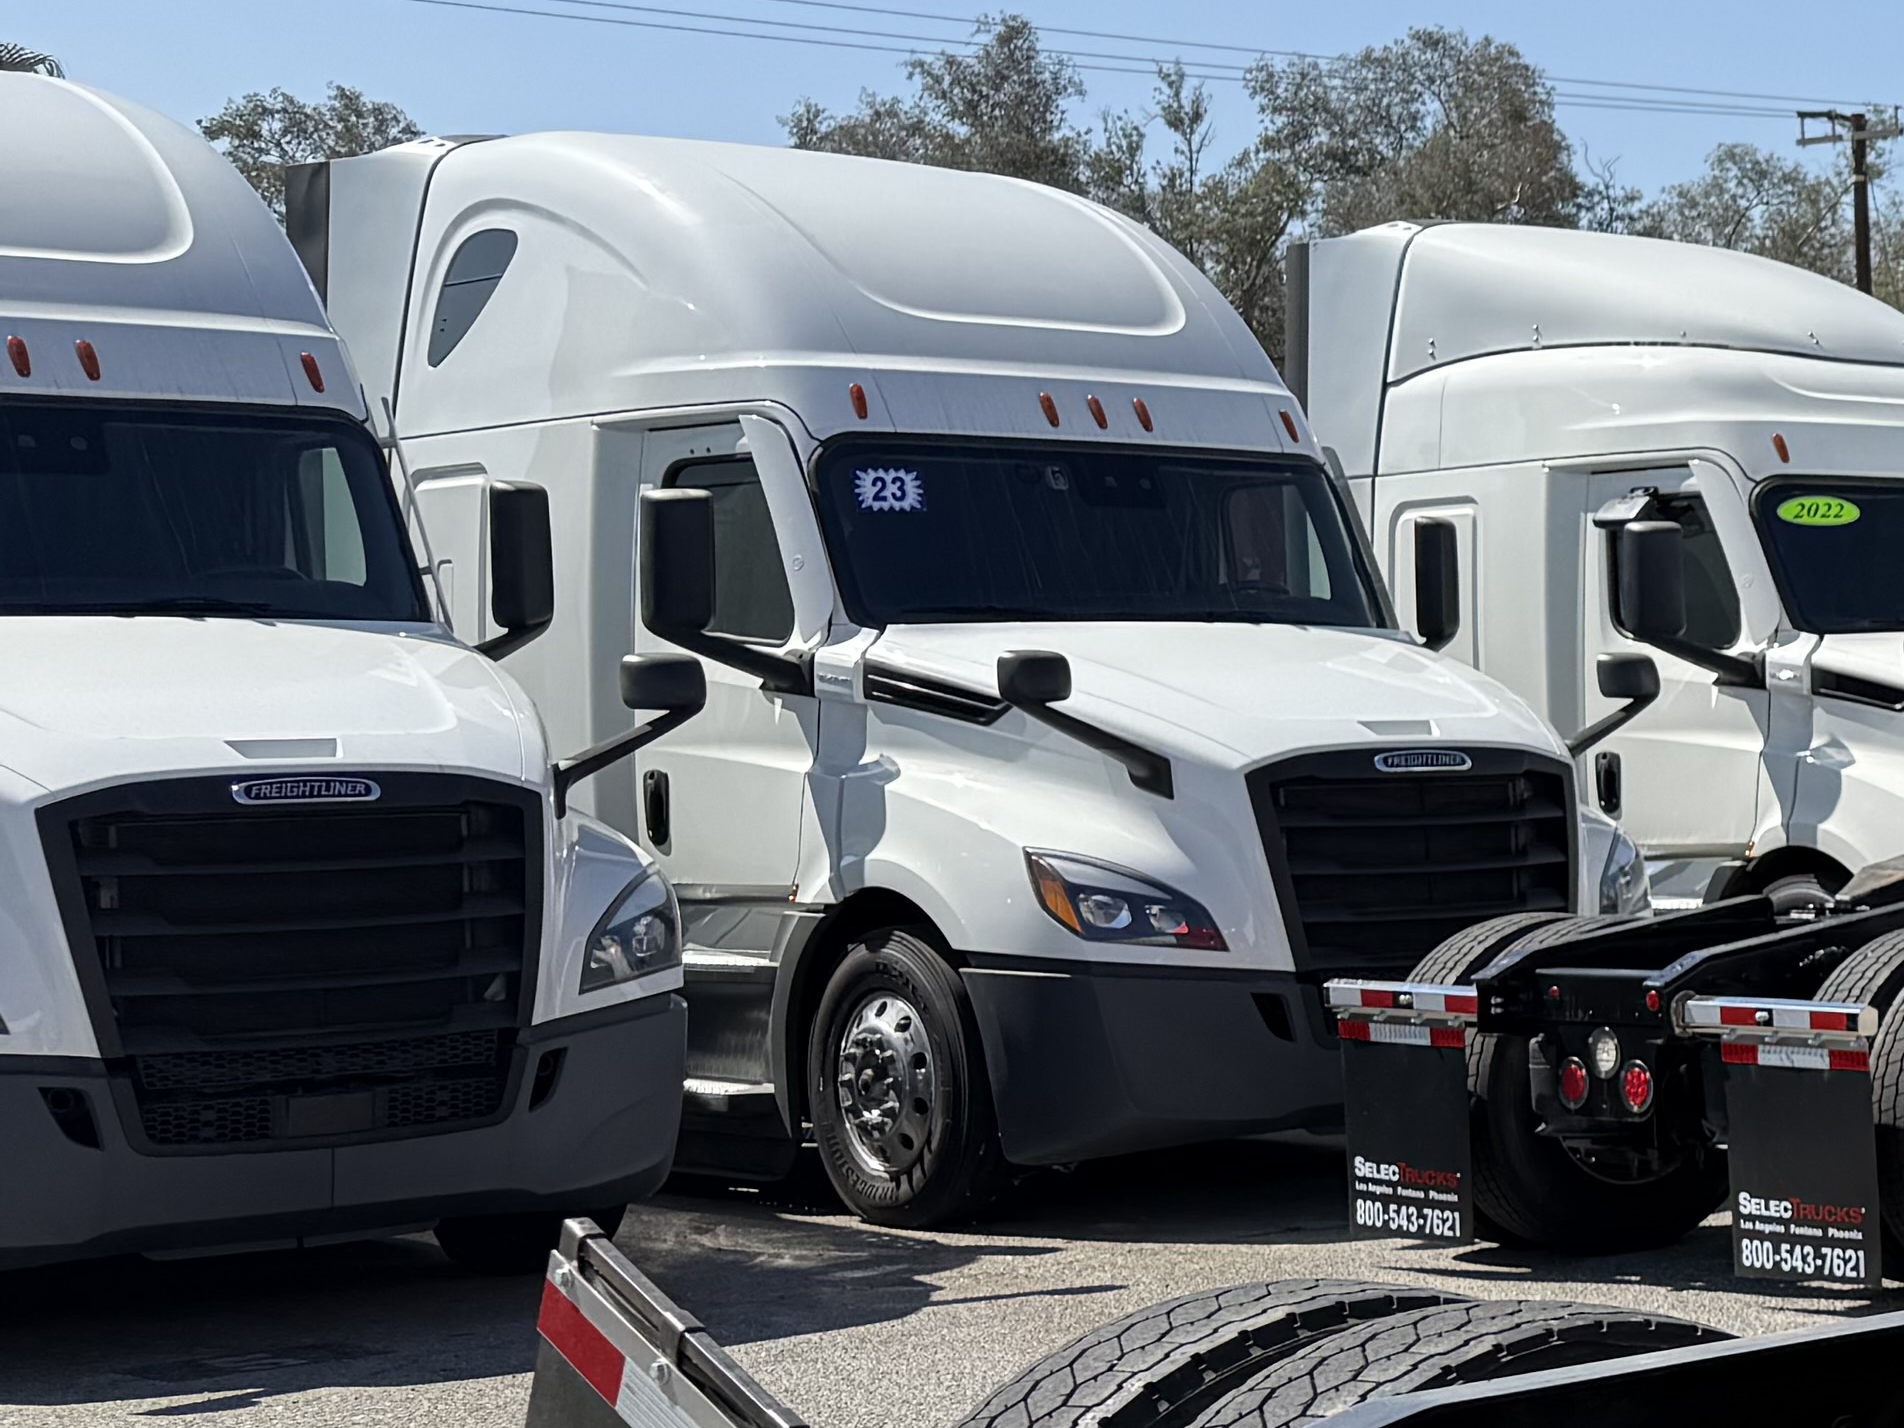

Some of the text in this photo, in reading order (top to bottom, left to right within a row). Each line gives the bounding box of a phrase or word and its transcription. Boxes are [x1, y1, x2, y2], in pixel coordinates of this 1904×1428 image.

[871, 476, 906, 502] 23
[1793, 502, 1845, 520] 2022
[250, 781, 366, 798] FREIGHTLINER
[1356, 1198, 1461, 1238] 800-543-7621
[1740, 1218, 1863, 1241] Los Angeles Fontana Phoenix
[1741, 1238, 1866, 1279] 800-543-7621
